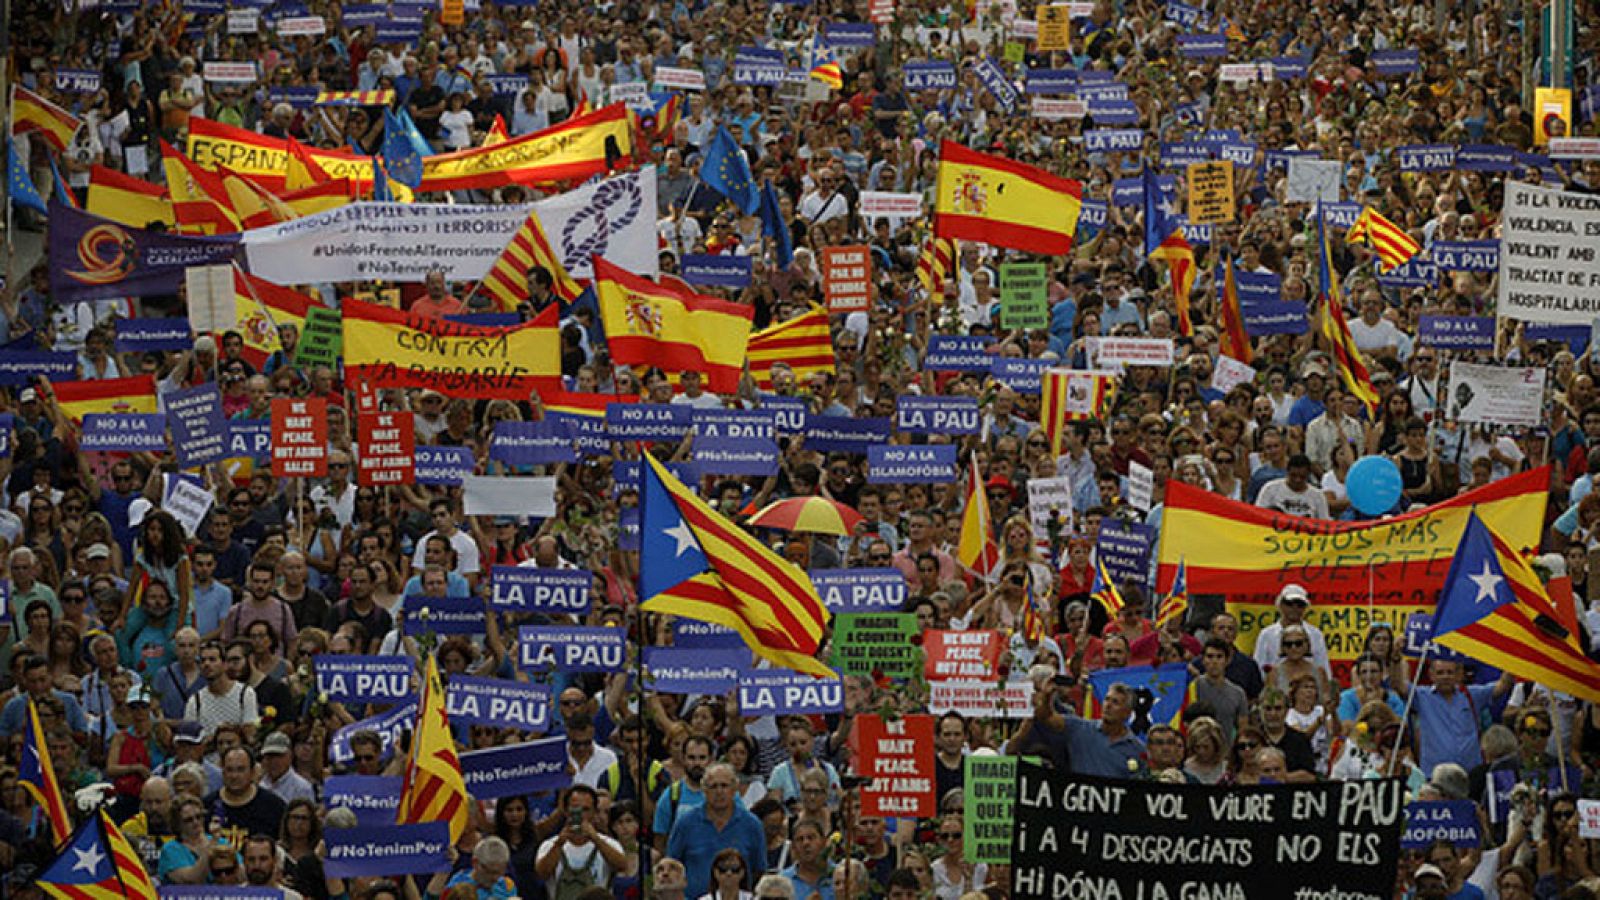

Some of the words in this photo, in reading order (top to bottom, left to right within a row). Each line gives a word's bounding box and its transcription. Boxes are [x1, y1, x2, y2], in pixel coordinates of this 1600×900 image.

[738, 70, 755, 81] LA
[759, 71, 785, 82] PAU
[905, 74, 922, 86] LA
[928, 73, 956, 86] PAU
[1111, 134, 1141, 148] PAU
[1400, 155, 1421, 169] LA
[1425, 154, 1453, 168] PAU
[1532, 193, 1550, 208] LA
[1082, 208, 1106, 224] AU
[1434, 253, 1456, 268] LA
[1462, 253, 1499, 268] PAU
[1567, 247, 1595, 261] AMB
[1508, 267, 1564, 284] TRACTAT
[1434, 321, 1449, 331] NO
[1454, 321, 1461, 331] A
[1465, 321, 1478, 331] LA
[397, 331, 509, 357] CONTRA
[940, 340, 957, 351] NO
[960, 340, 968, 350] A
[926, 354, 991, 365] ISLAMOFÒBI
[1028, 364, 1037, 373] A
[291, 403, 307, 413] WE
[622, 408, 642, 420] NO
[646, 409, 655, 419] A
[657, 408, 673, 419] LA
[97, 418, 118, 430] NO
[120, 419, 129, 430] A
[131, 418, 148, 430] LA
[285, 416, 313, 427] WANT
[774, 410, 805, 429] AU
[899, 411, 927, 428] LA
[933, 411, 978, 428] PAU
[434, 452, 443, 463] A
[446, 452, 461, 464] LA
[696, 449, 776, 463] #NoTenimPor
[884, 451, 905, 461] NO
[908, 452, 918, 461] A
[920, 451, 936, 461] LA
[284, 461, 316, 472] SALES
[493, 584, 526, 604] LA
[535, 586, 589, 607] PAU
[851, 585, 905, 606] PAU
[943, 633, 959, 644] WE
[961, 633, 991, 645] WANT
[523, 645, 557, 665] LA
[565, 646, 622, 667] PAU
[315, 674, 349, 696] LA
[357, 673, 410, 696] PAU
[740, 687, 776, 709] LA
[785, 687, 842, 708] PAU
[448, 692, 481, 718] LA
[490, 697, 546, 725] PAU
[886, 720, 906, 734] WE
[877, 739, 915, 753] WANT
[461, 760, 564, 786] #NoTenimPor
[892, 777, 931, 792] ARMS
[877, 797, 919, 812] SALES
[1020, 776, 1053, 807] LA
[1063, 783, 1126, 815] GENT
[1145, 793, 1187, 820] VOL
[1292, 792, 1326, 819] EN
[1338, 781, 1399, 826] PAU
[976, 802, 1005, 819] QUE
[1416, 809, 1427, 820] A
[1432, 808, 1453, 820] LA
[330, 841, 442, 859] #NoTenimPor
[976, 843, 1009, 859] ARM
[1039, 826, 1057, 852] A
[1071, 825, 1089, 854] 4
[1276, 835, 1322, 863] NO
[1336, 832, 1380, 865] ELS
[1052, 870, 1123, 900] DÓNA
